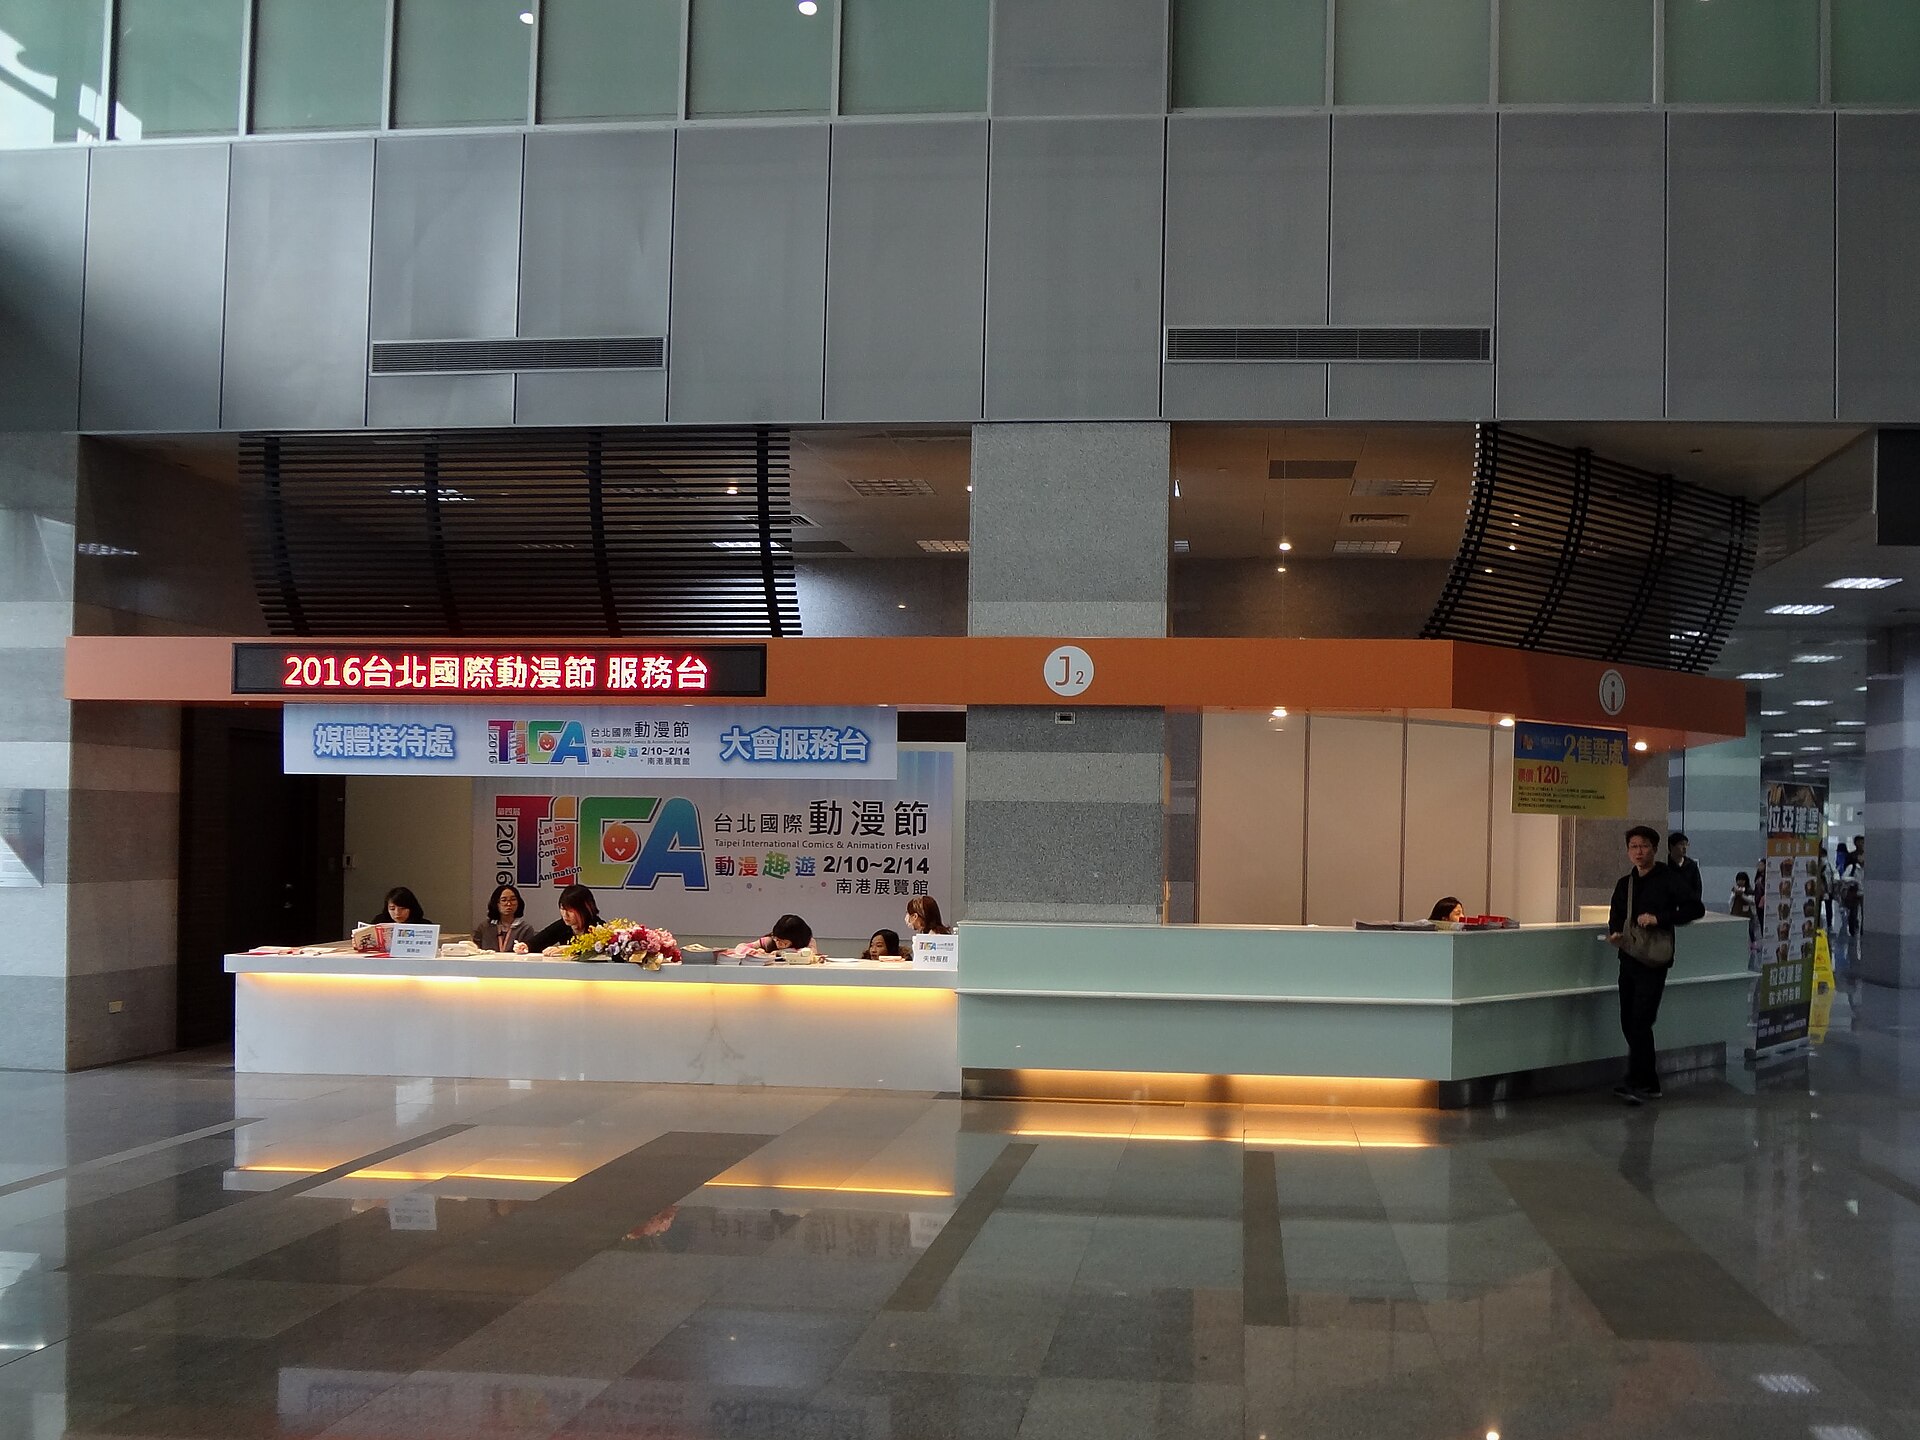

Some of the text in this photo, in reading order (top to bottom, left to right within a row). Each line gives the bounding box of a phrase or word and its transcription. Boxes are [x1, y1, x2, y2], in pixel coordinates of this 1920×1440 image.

[284, 655, 708, 689] 2016台北國際動漫節 服務台
[314, 724, 455, 758] 媒體接待處
[488, 720, 589, 765] TICA
[591, 721, 690, 738] 台北國際動漫節
[488, 733, 498, 764] 2016
[641, 747, 690, 755] 2/10~2/14
[720, 727, 869, 761] 大會服務台
[539, 827, 553, 836] Let
[714, 800, 929, 837] 台北國際動漫節
[496, 795, 709, 890] TICA
[538, 847, 566, 858] Comic
[539, 834, 569, 846] Among
[714, 839, 930, 850] Taipei International Comics & Animation Festival
[496, 823, 515, 886] 2016
[714, 851, 930, 879] 動漫趣遊 2/10~2/14
[539, 866, 583, 881] Animation
[836, 878, 929, 896] 南港展覽館
